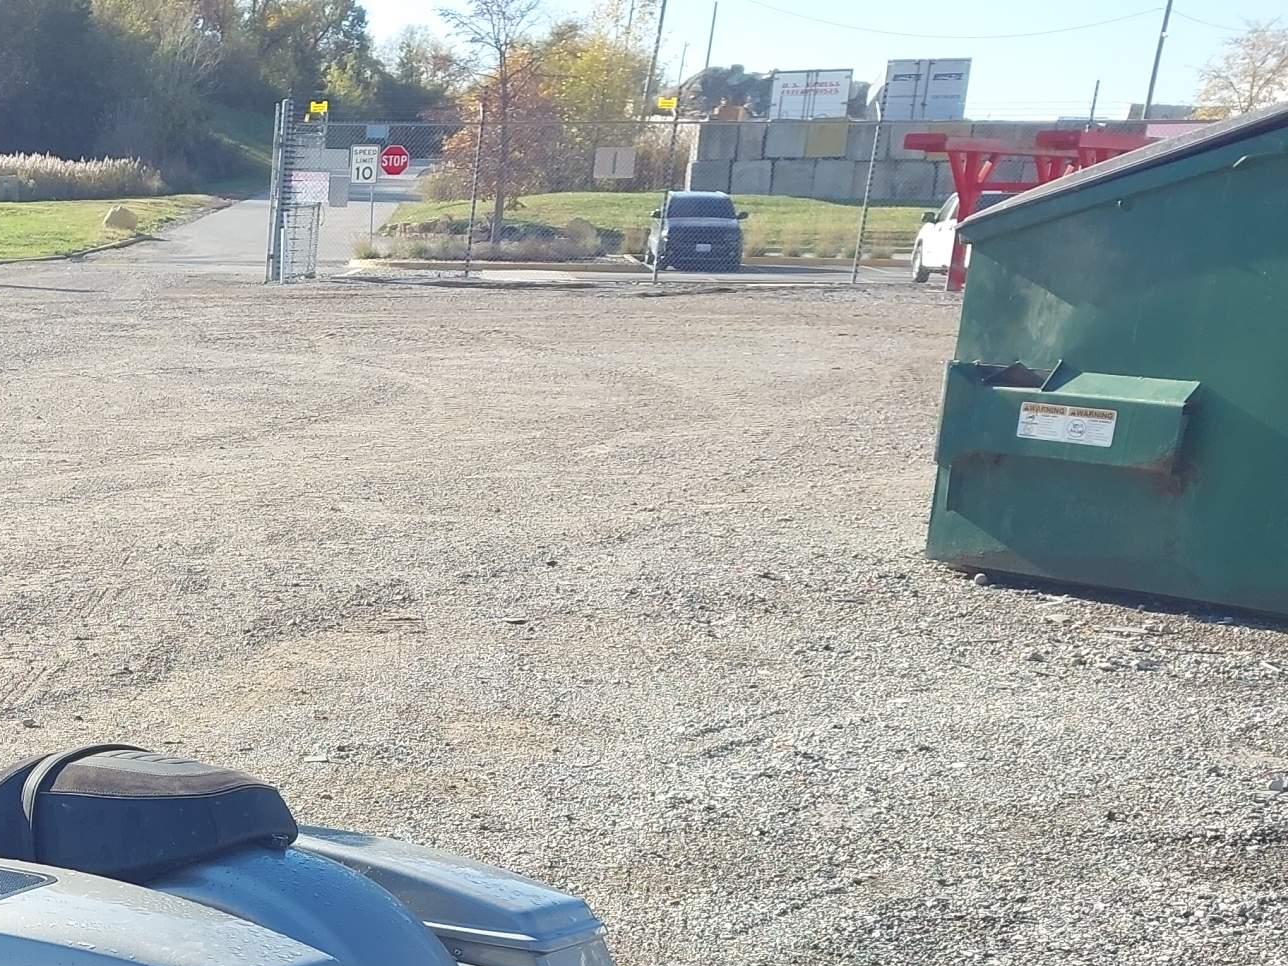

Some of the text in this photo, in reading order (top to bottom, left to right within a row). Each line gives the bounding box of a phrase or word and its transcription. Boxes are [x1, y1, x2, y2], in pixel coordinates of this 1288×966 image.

[382, 155, 408, 167] STOP
[355, 166, 373, 180] 10
[1029, 404, 1065, 415] WARNING
[1076, 410, 1114, 419] WARNING
